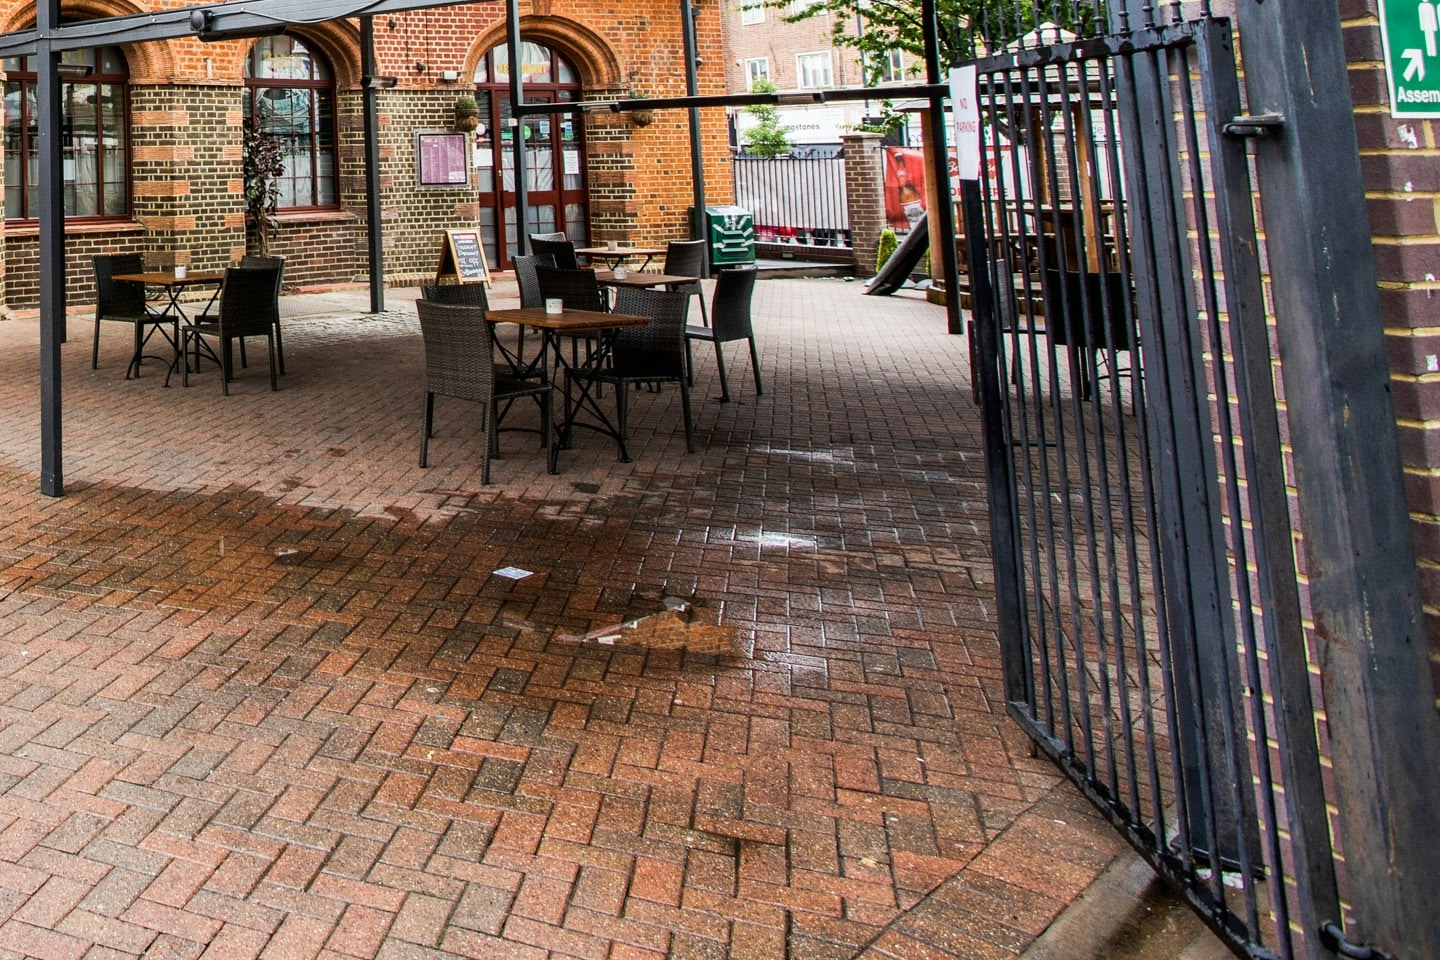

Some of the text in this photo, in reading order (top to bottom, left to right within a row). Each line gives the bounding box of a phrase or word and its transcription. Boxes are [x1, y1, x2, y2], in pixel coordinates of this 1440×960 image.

[1397, 86, 1440, 103] Assem
[960, 98, 967, 109] NO
[956, 121, 976, 132] PARKING
